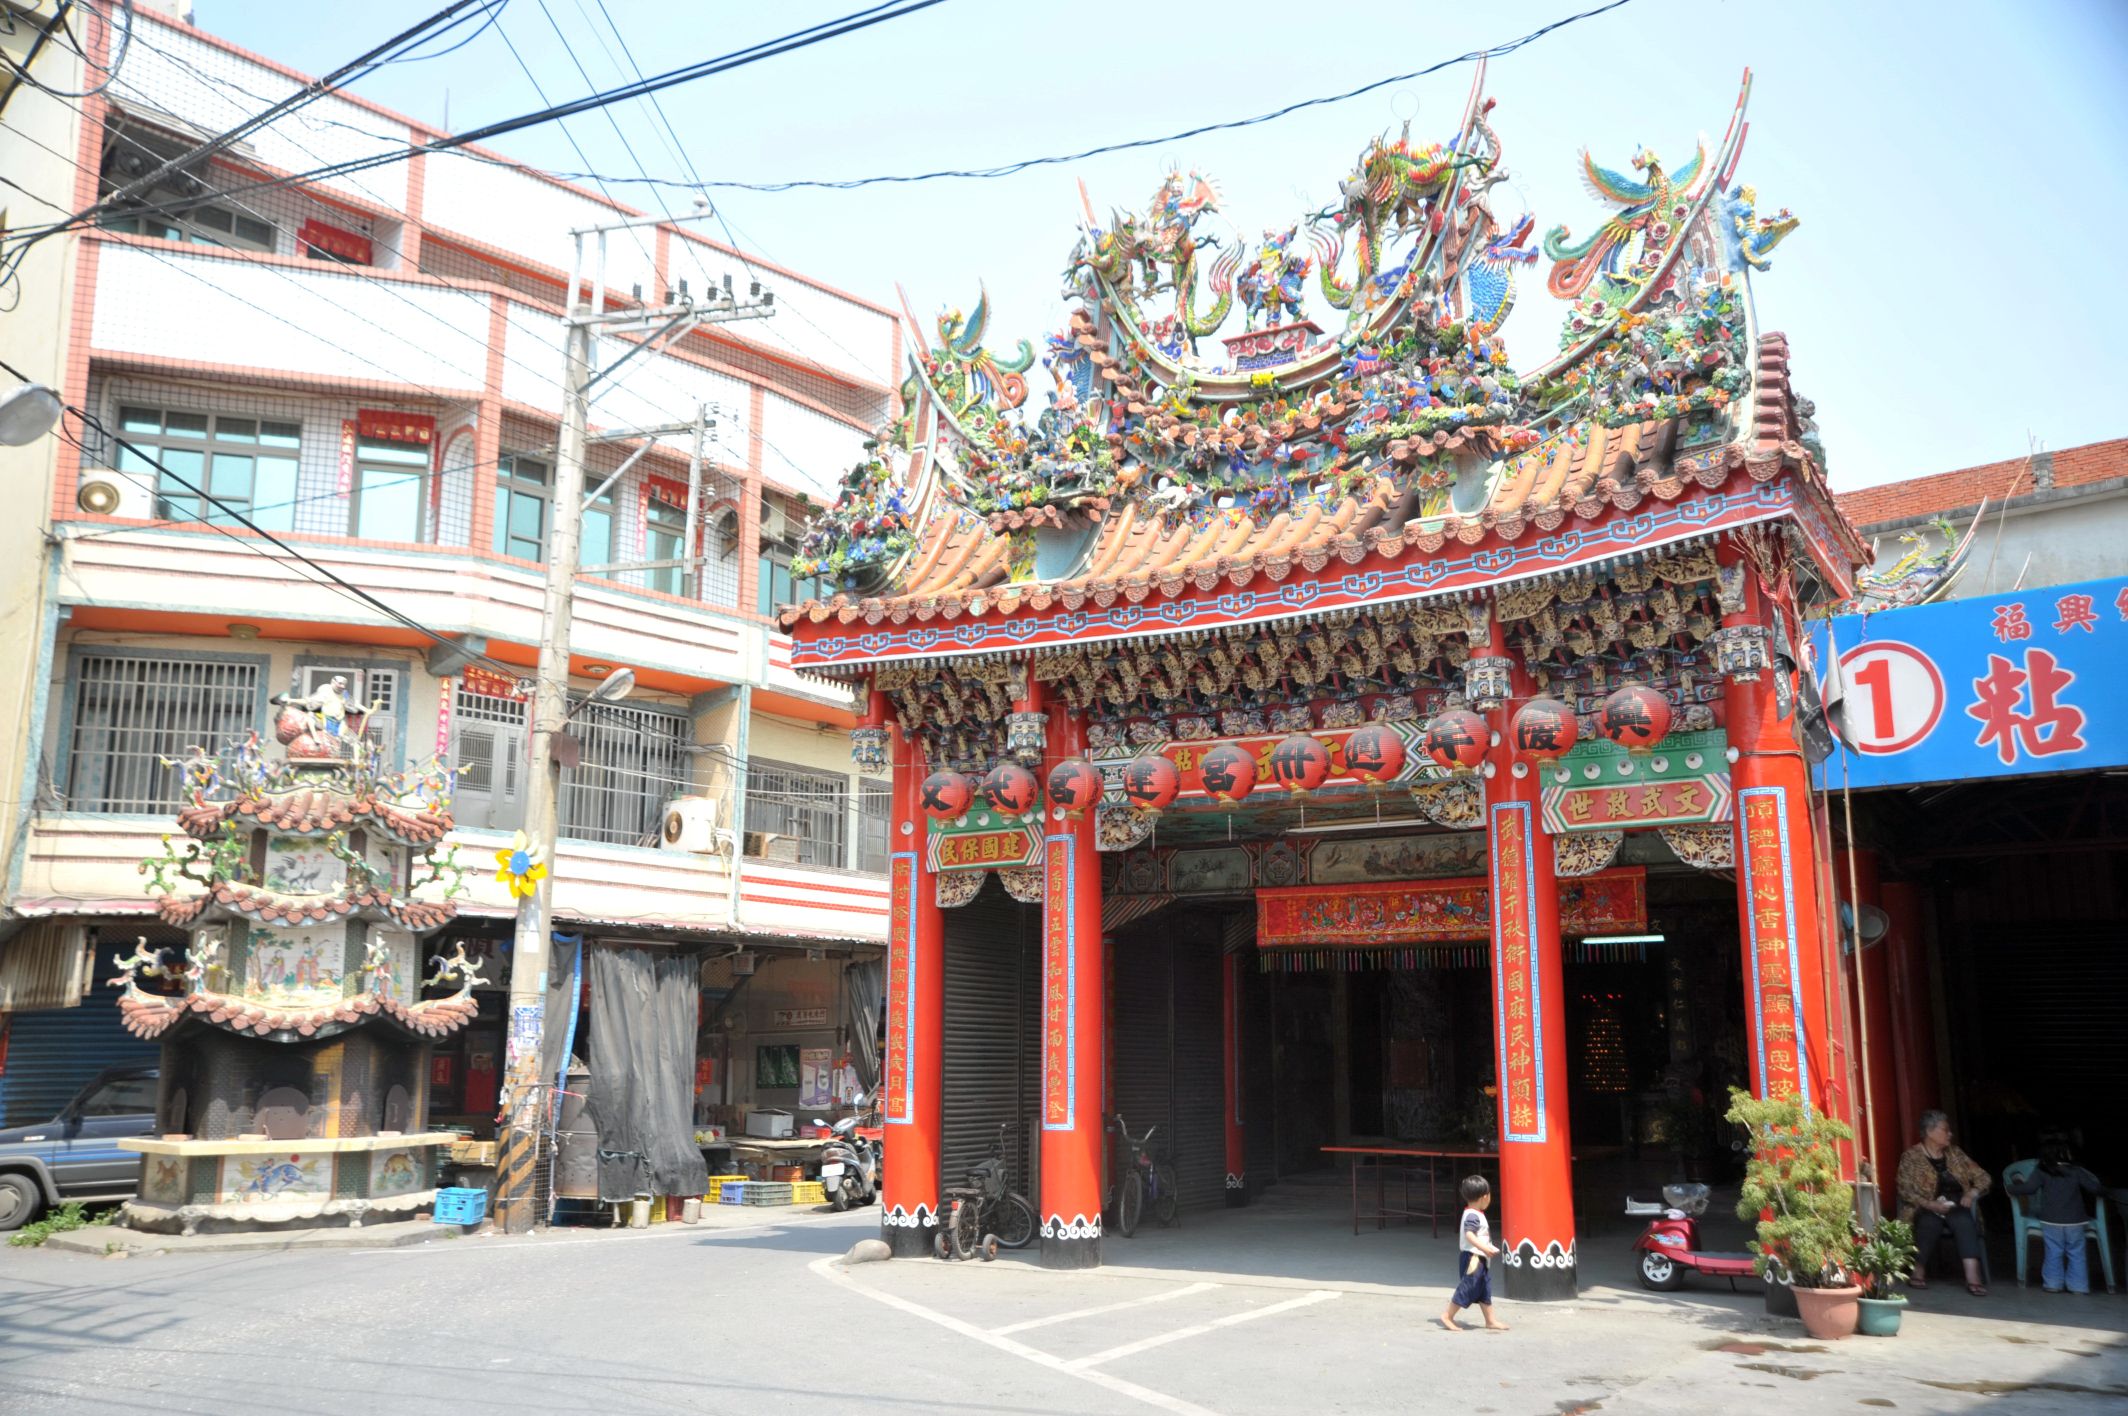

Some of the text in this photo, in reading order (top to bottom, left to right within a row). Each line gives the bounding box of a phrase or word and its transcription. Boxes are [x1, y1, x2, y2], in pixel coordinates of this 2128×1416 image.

[1990, 586, 2128, 643] 福興
[1854, 658, 1895, 740] 1
[1967, 647, 2088, 766] 粘
[1568, 784, 1704, 822] 文武救世
[941, 831, 1023, 866] 建國保民
